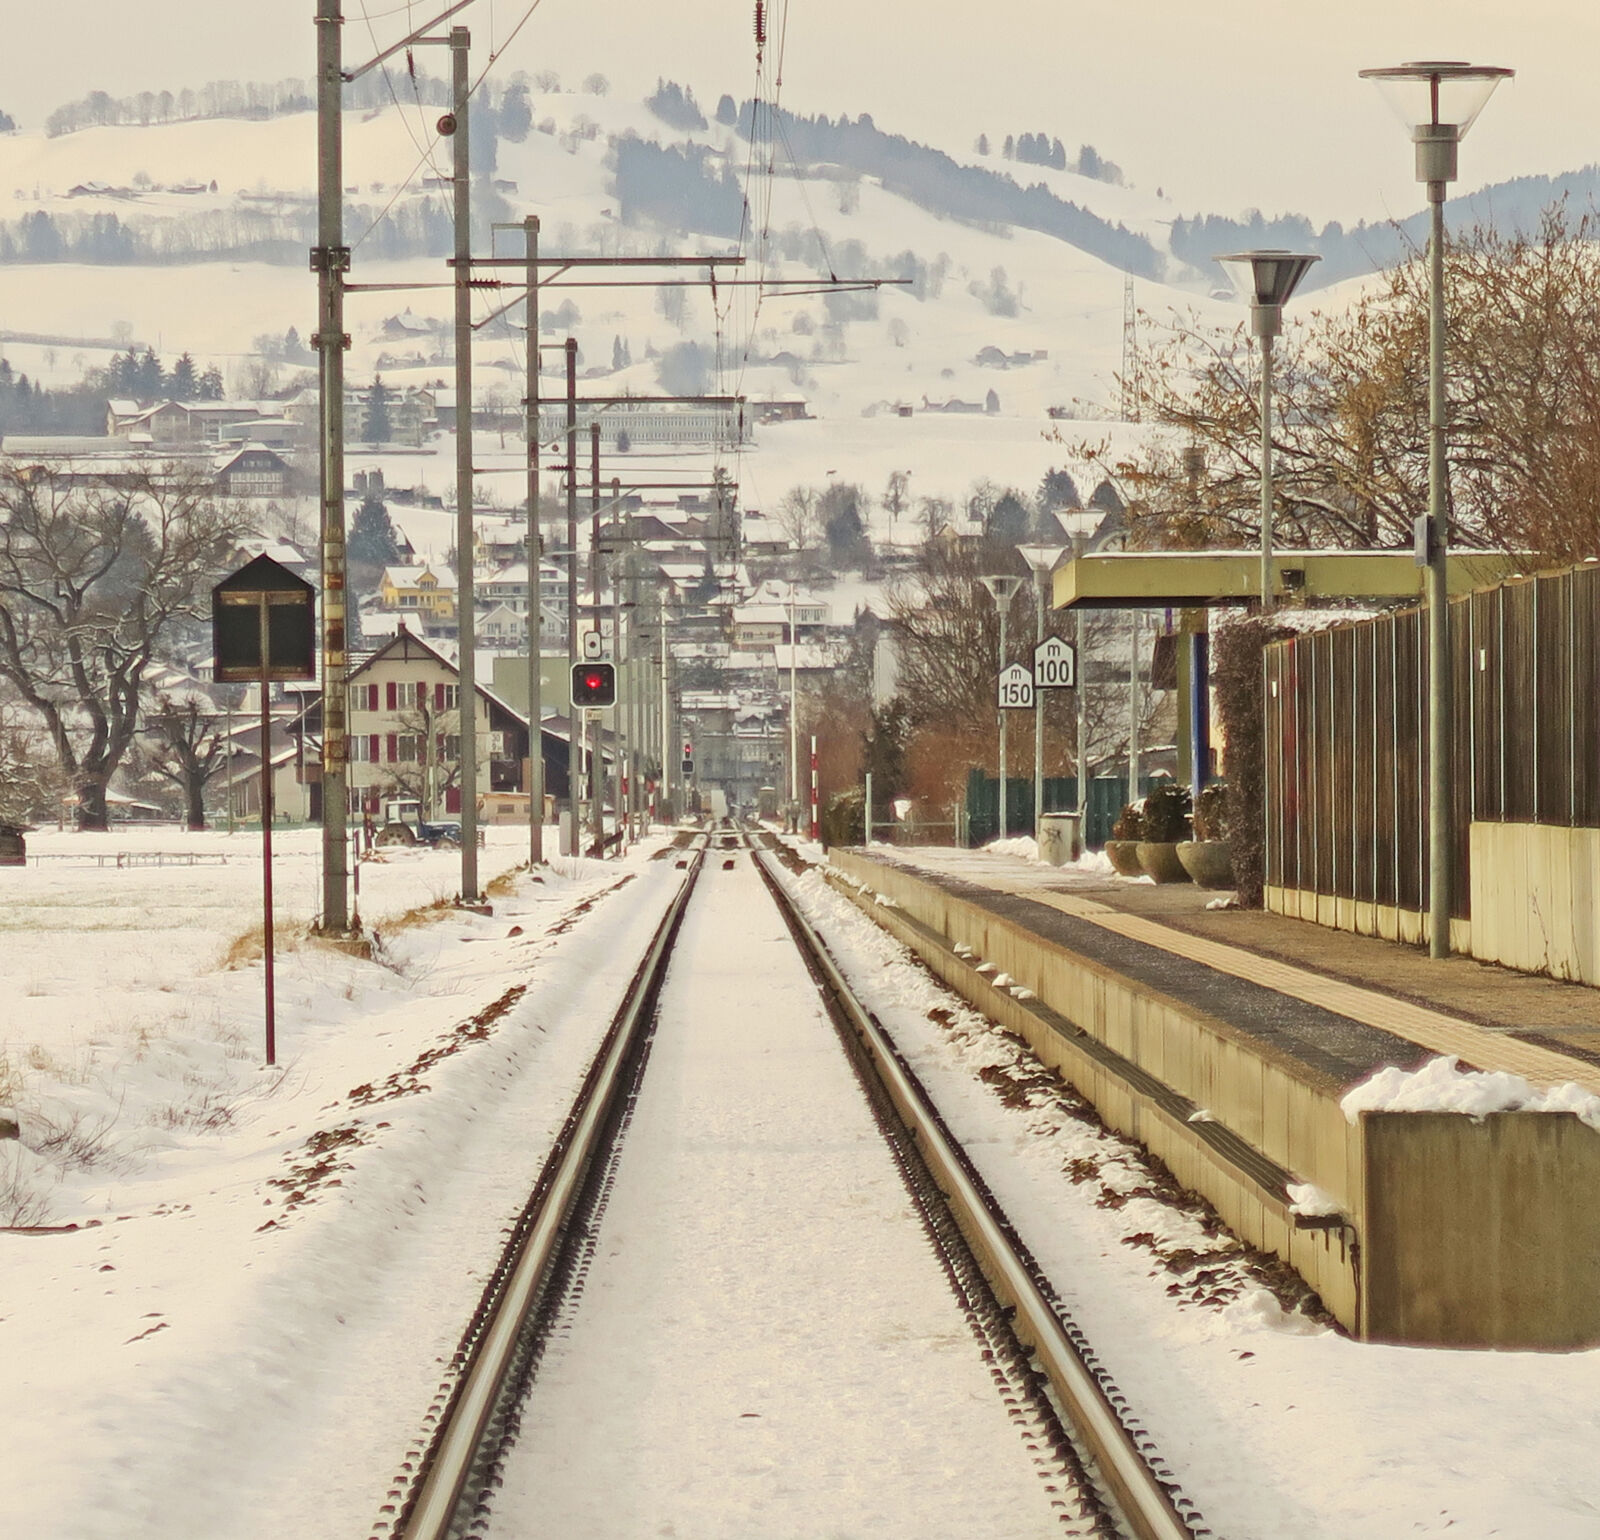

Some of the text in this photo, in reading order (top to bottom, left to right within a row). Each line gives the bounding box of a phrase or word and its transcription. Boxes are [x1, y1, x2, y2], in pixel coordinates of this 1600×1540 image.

[1047, 644, 1060, 656] m
[1010, 669, 1021, 680] m
[1037, 660, 1069, 683] 100
[1001, 684, 1030, 704] 150
